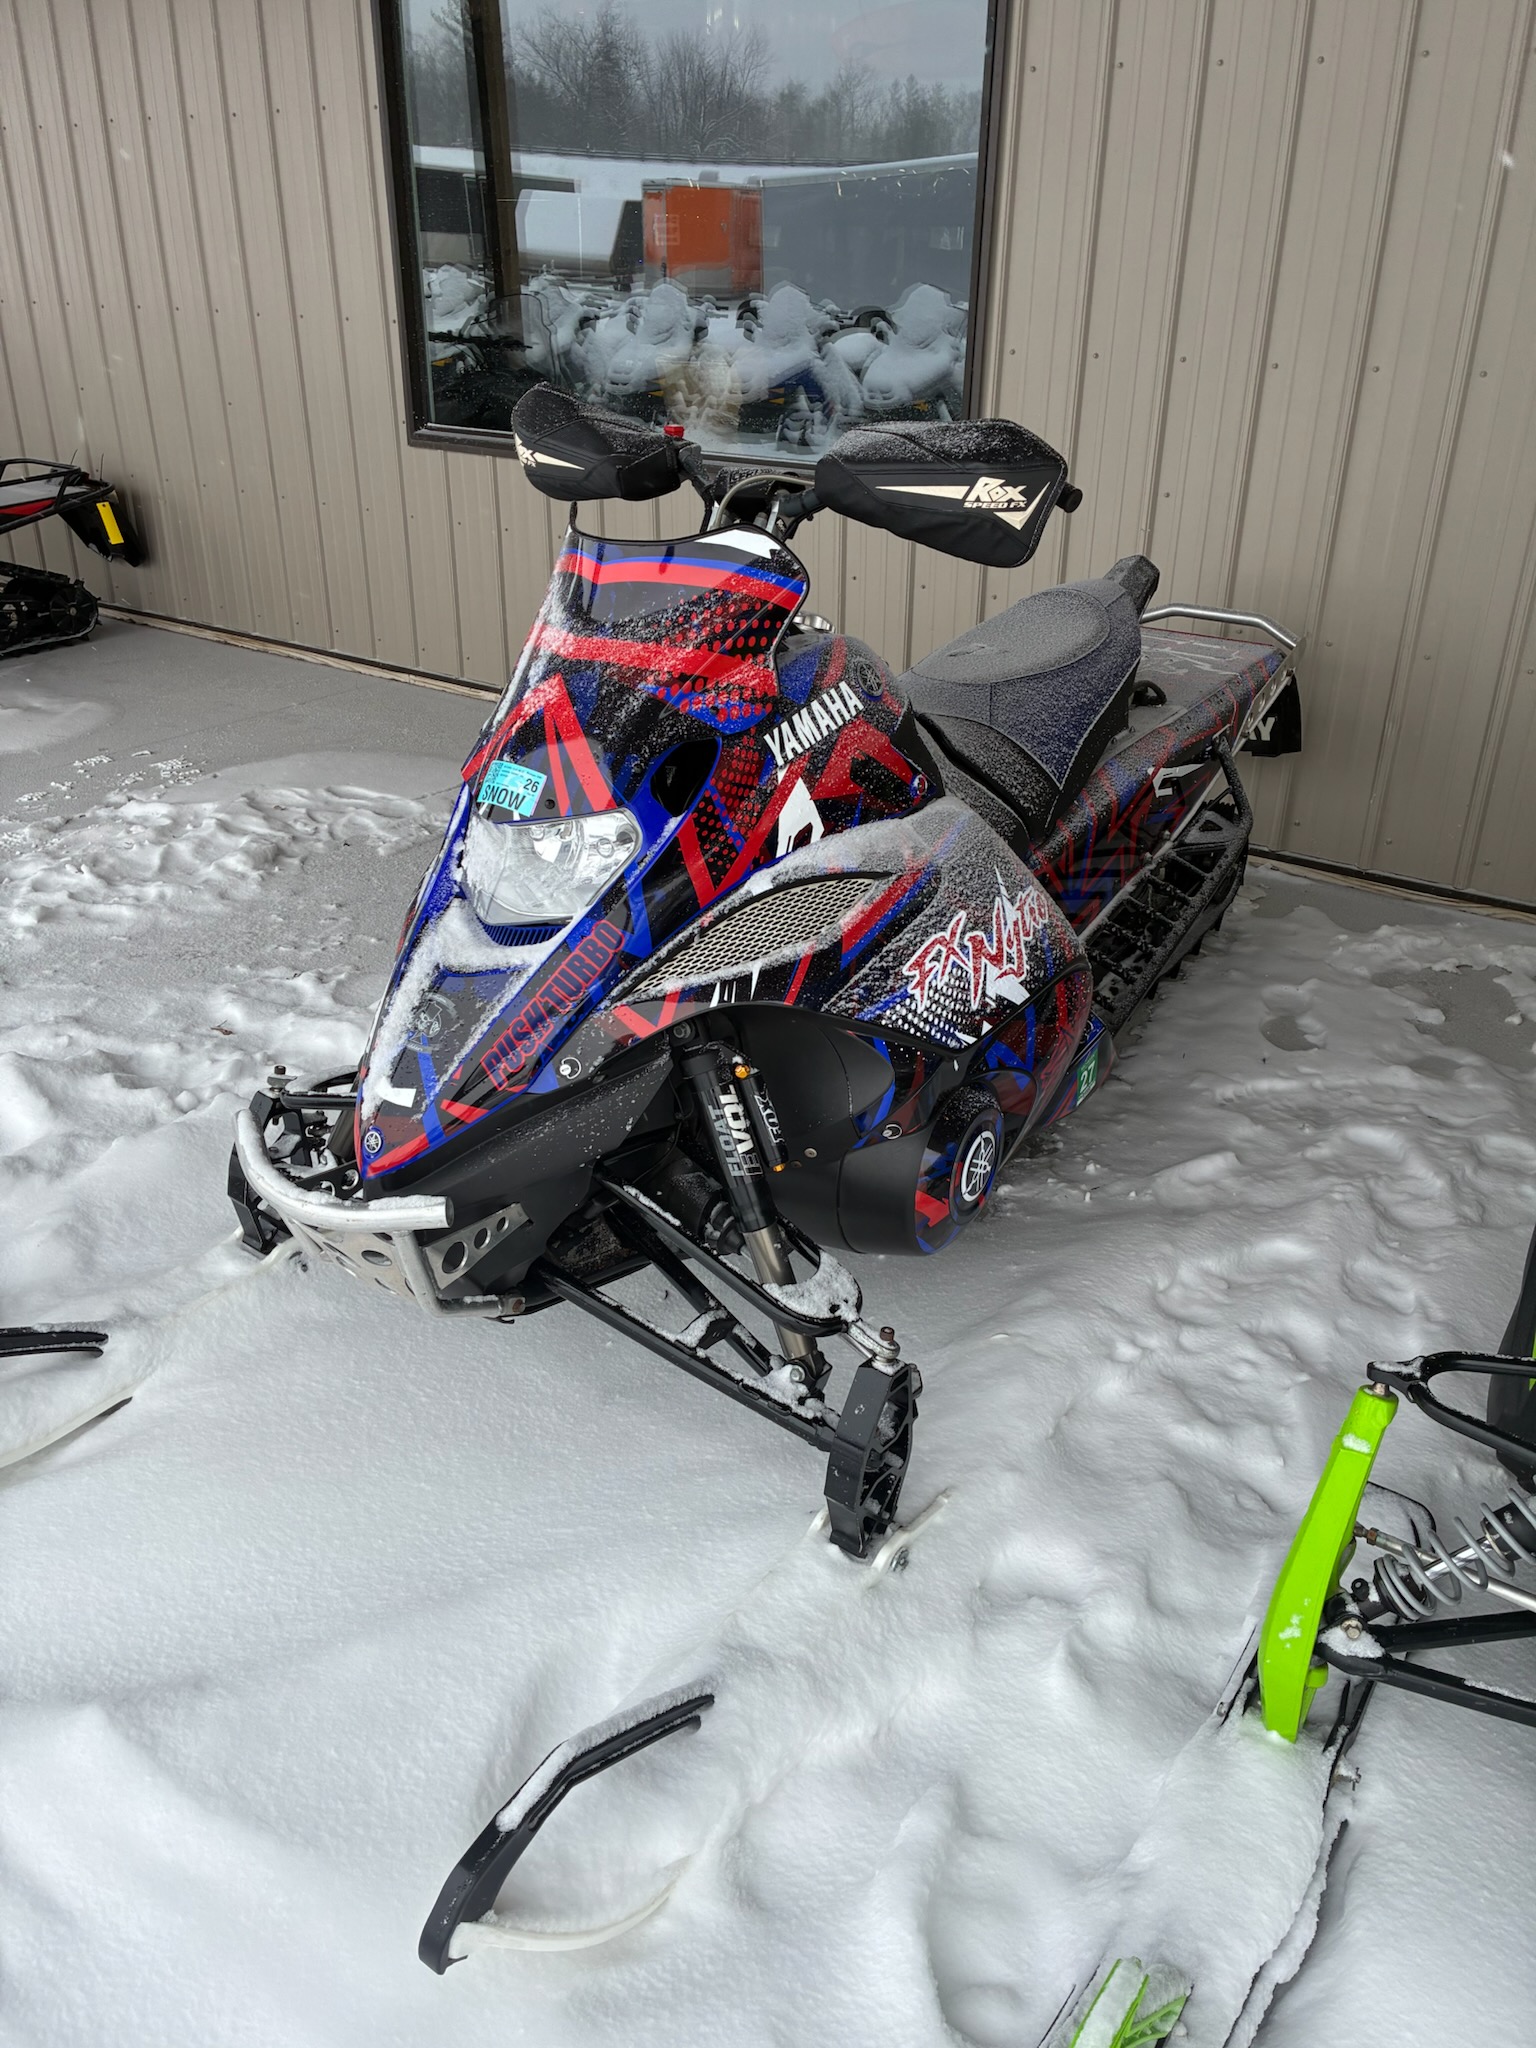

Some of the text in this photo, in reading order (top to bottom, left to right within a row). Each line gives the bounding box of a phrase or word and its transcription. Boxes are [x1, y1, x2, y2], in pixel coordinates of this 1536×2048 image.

[963, 501, 1027, 509] SPEED FX
[763, 680, 865, 768] YAMAHA
[482, 784, 526, 811] SNOW
[523, 778, 540, 793] 26
[1080, 1060, 1096, 1093] 27
[719, 1084, 763, 1176] EVOL
[754, 1088, 785, 1144] FOX
[708, 1105, 744, 1176] FLOAT
